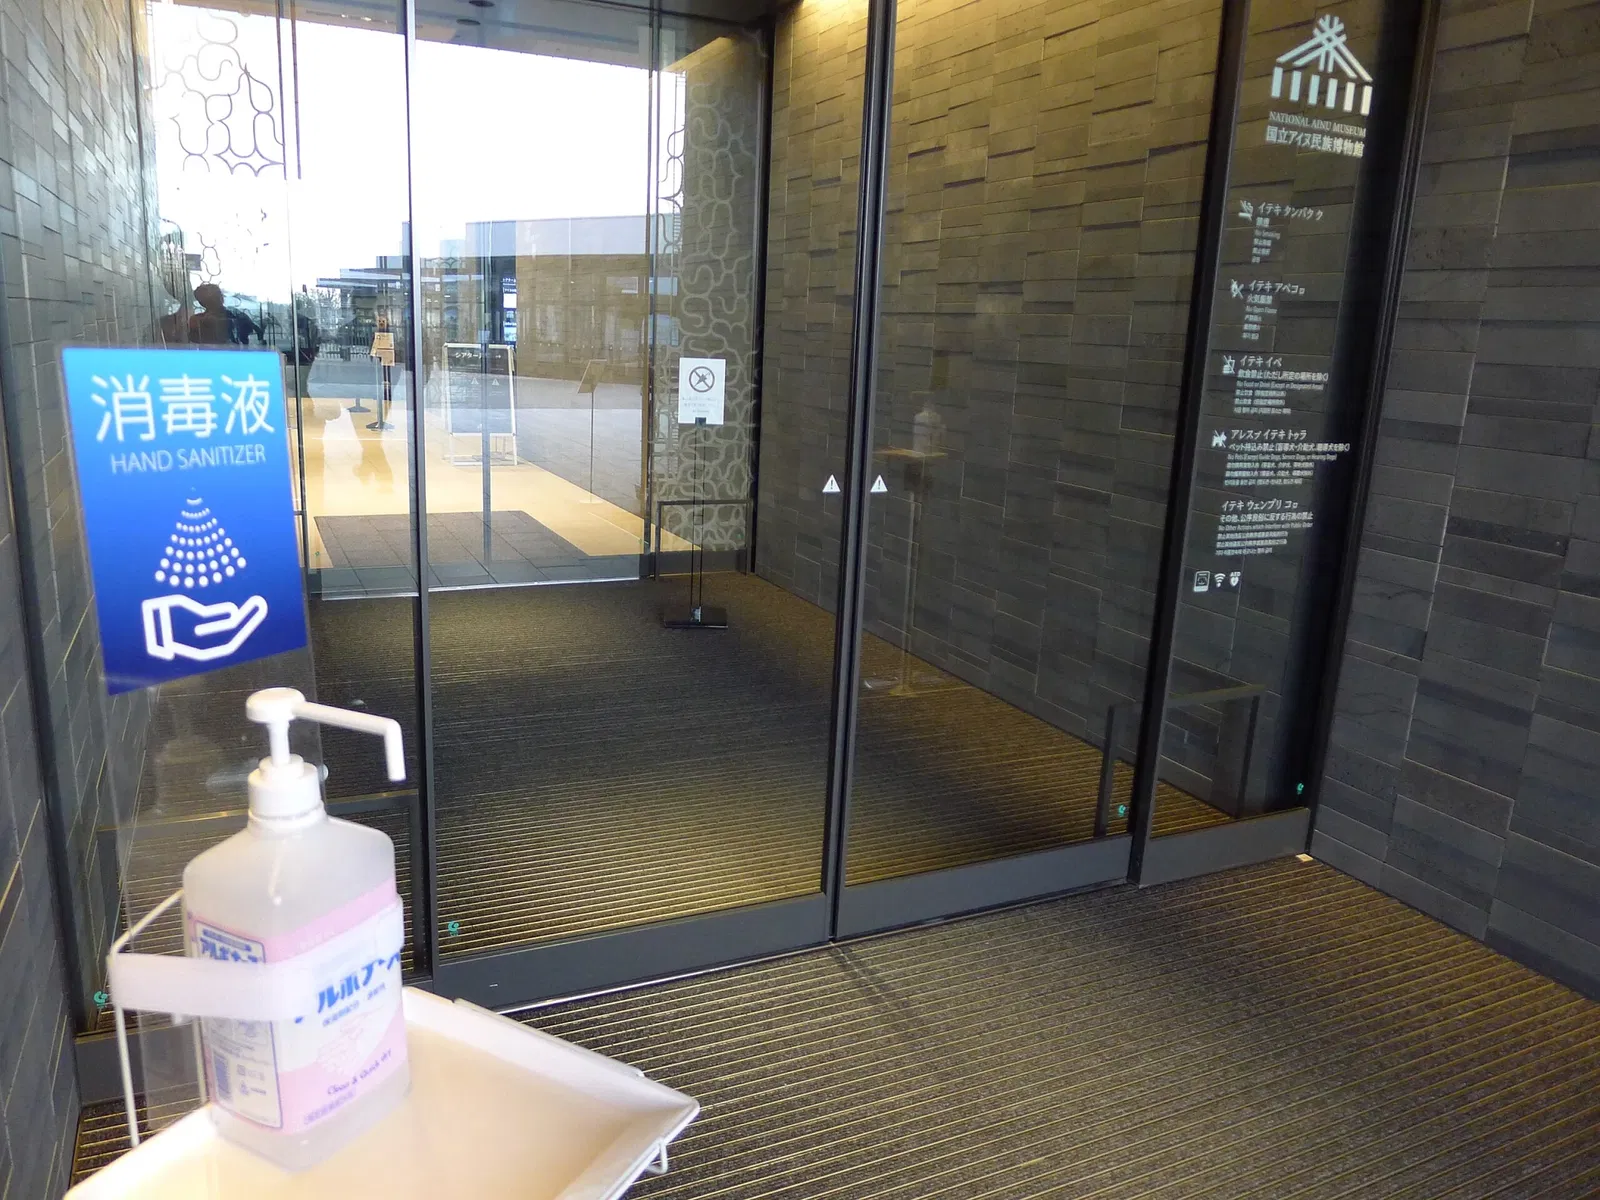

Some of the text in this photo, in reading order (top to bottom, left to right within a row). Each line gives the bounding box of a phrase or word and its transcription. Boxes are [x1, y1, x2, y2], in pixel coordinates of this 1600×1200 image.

[1269, 111, 1366, 138] NATIONAL AINU MUSEUM
[1266, 125, 1365, 158] 国立アイヌ民族博物館
[1258, 202, 1282, 216] イテキ
[1248, 280, 1273, 292] イテキ
[1240, 355, 1264, 367] イテキ
[90, 373, 275, 442] 消毒液
[1263, 429, 1286, 440] イテキ
[110, 443, 266, 474] HAND SANITIZER
[1221, 500, 1244, 511] イテキ
